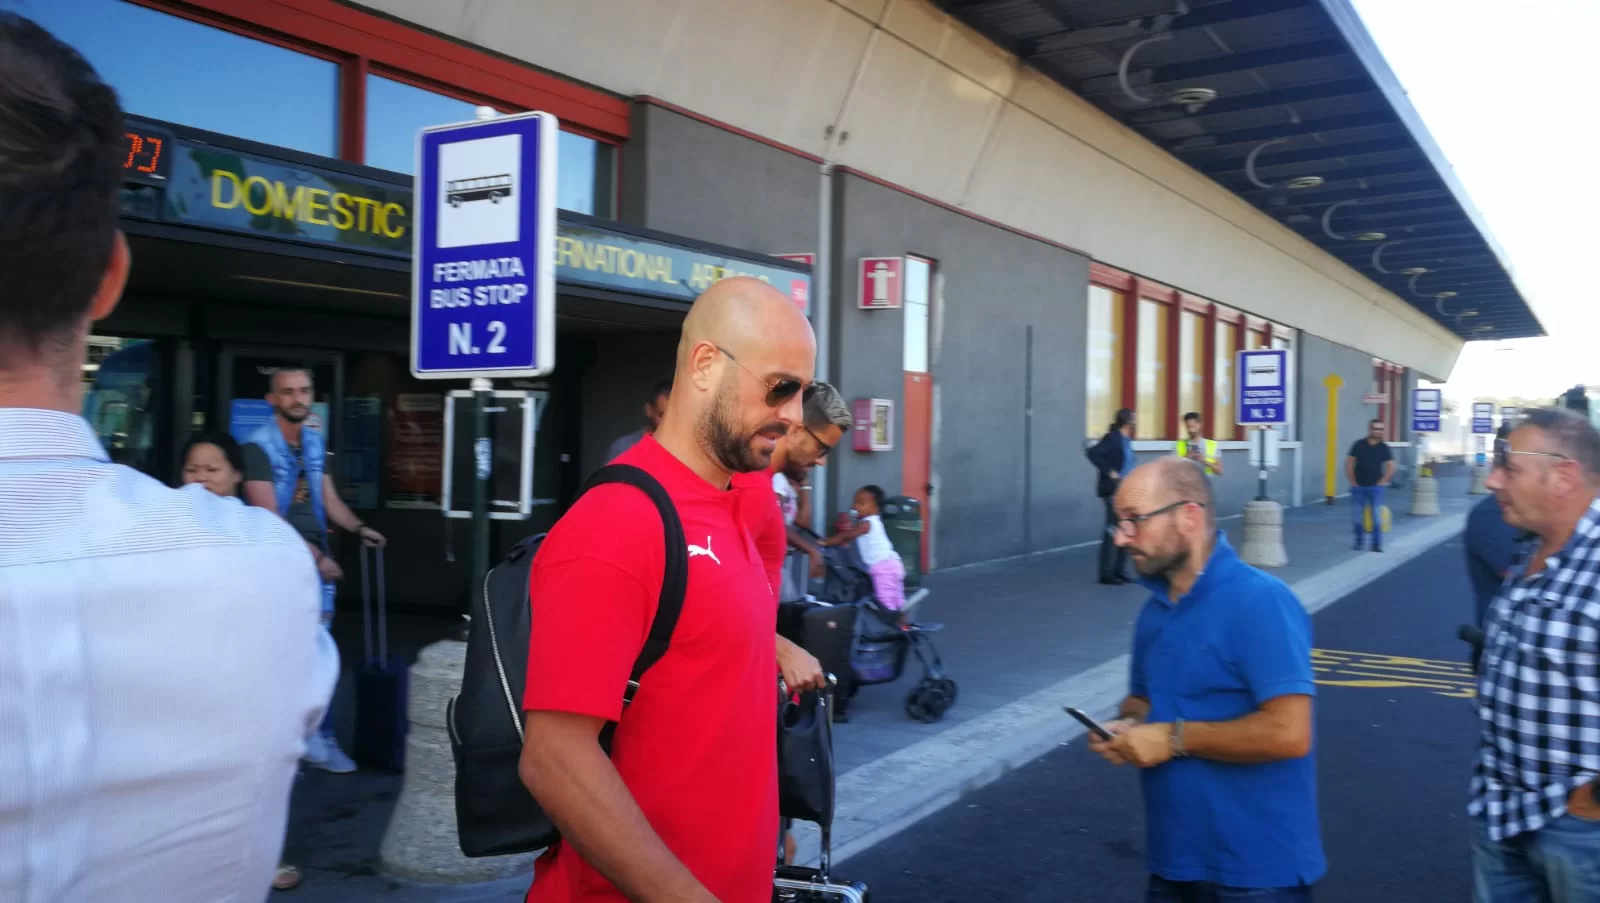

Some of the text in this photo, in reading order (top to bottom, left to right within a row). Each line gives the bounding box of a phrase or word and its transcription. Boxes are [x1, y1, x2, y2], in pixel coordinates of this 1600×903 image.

[211, 169, 405, 238] DOMESTIC
[433, 256, 525, 283] FERMATA
[430, 283, 529, 309] BUS STOP
[448, 320, 507, 355] N. 2
